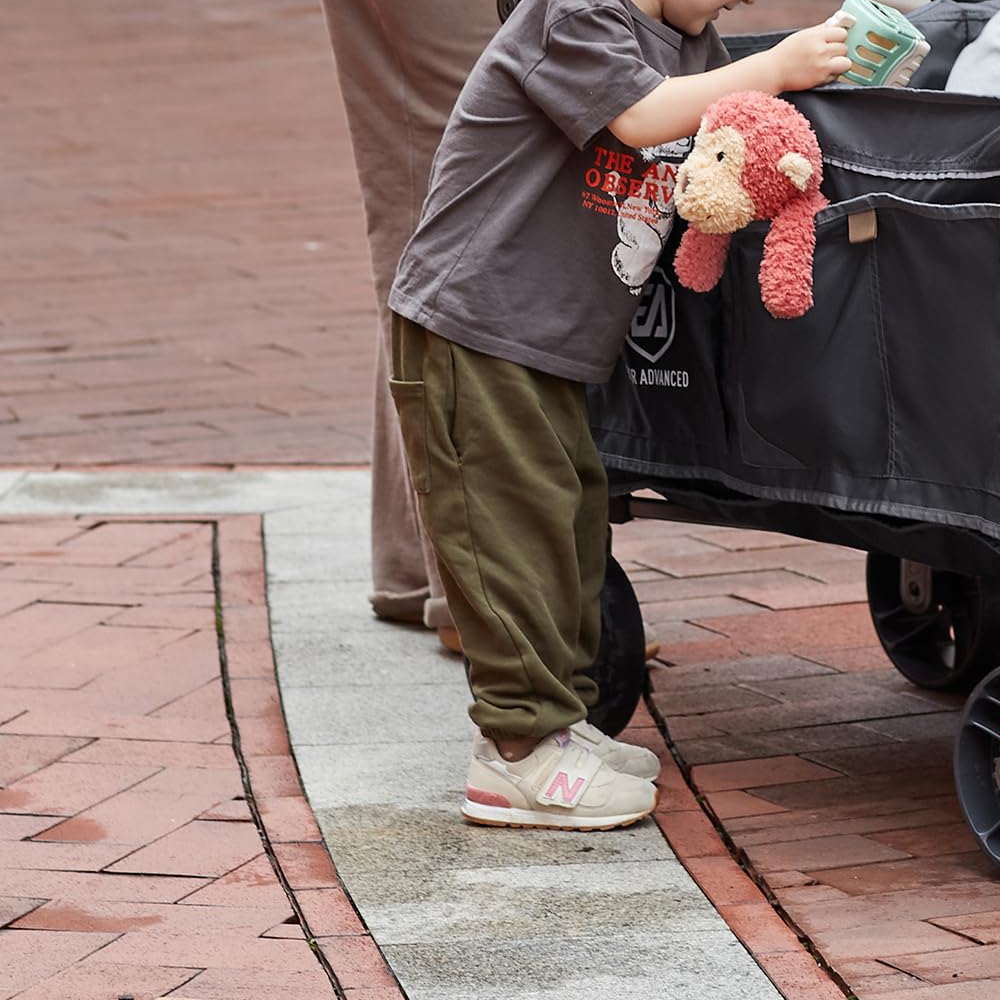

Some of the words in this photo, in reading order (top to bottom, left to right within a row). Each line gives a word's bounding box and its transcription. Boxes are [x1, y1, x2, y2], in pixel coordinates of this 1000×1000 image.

[594, 146, 635, 174] THE
[642, 162, 676, 182] AN
[585, 168, 675, 205] OBSERV
[640, 368, 690, 388] ADVANCED
[543, 770, 585, 803] N
